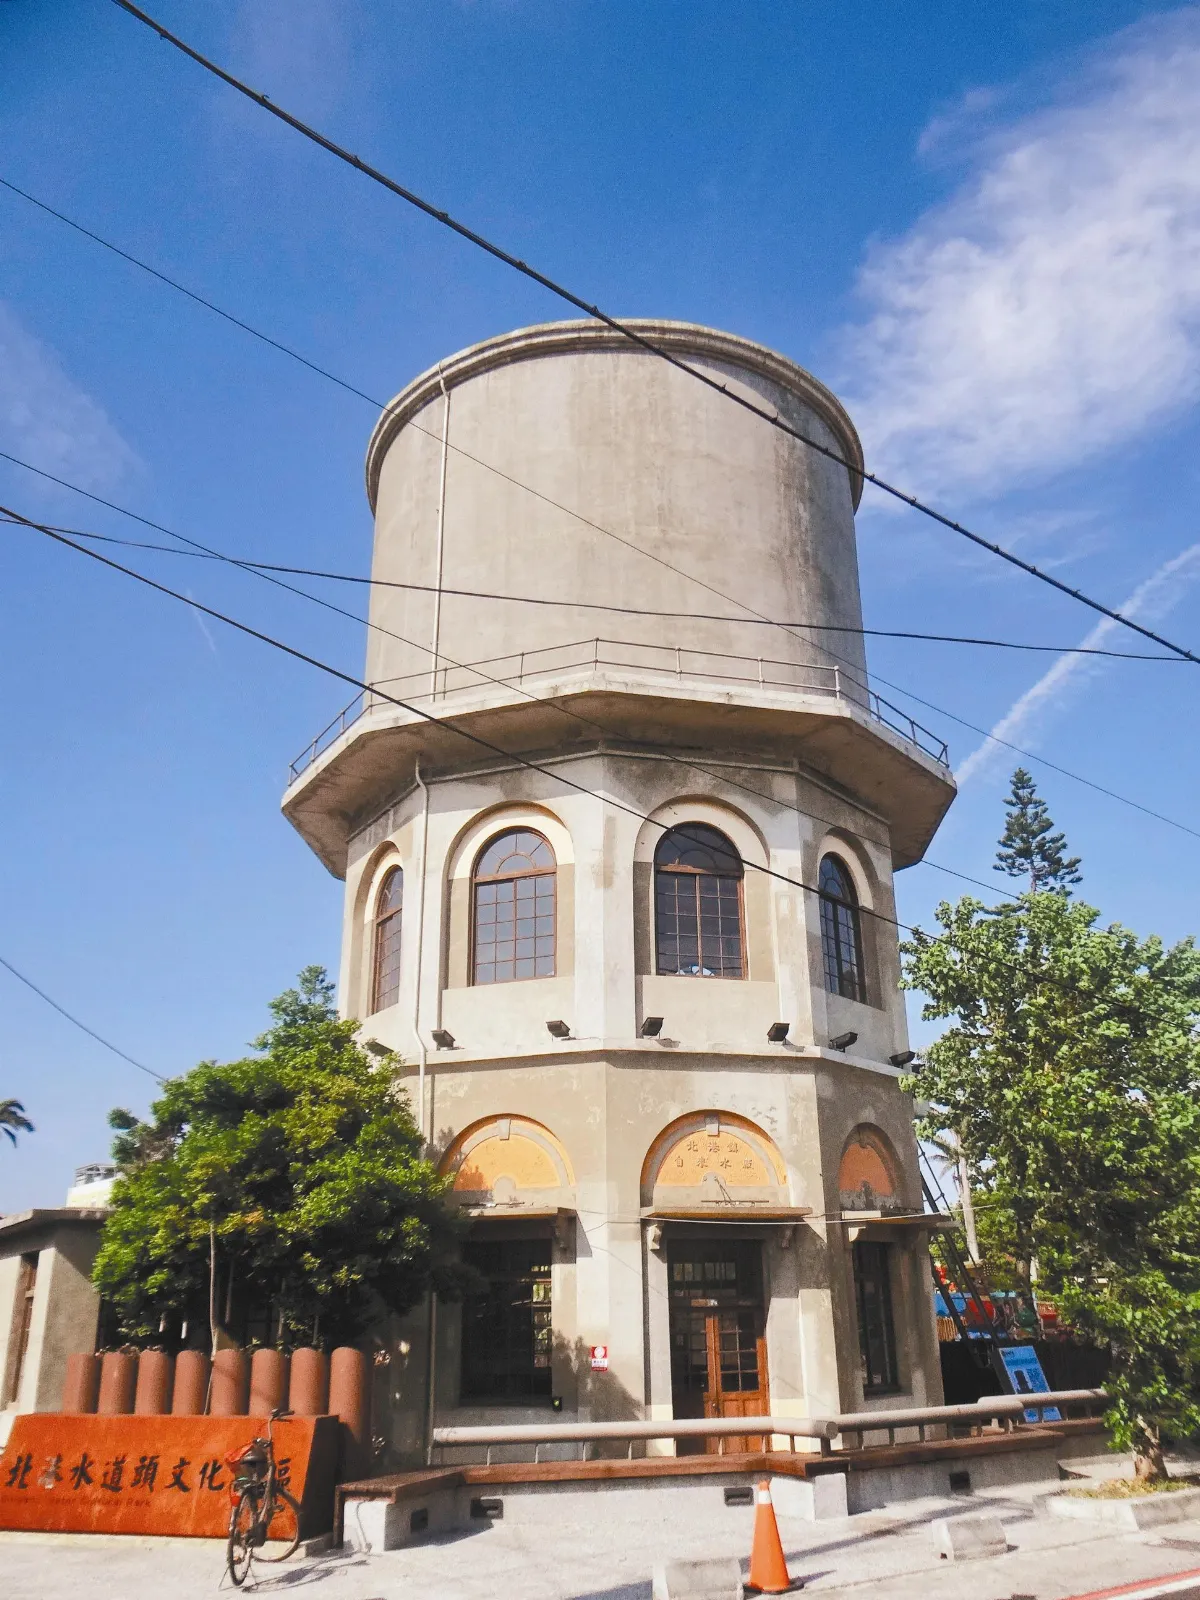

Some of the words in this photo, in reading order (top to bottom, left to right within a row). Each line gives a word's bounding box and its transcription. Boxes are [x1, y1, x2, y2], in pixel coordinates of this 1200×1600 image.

[5, 1452, 292, 1493] 北水道頭文化區
